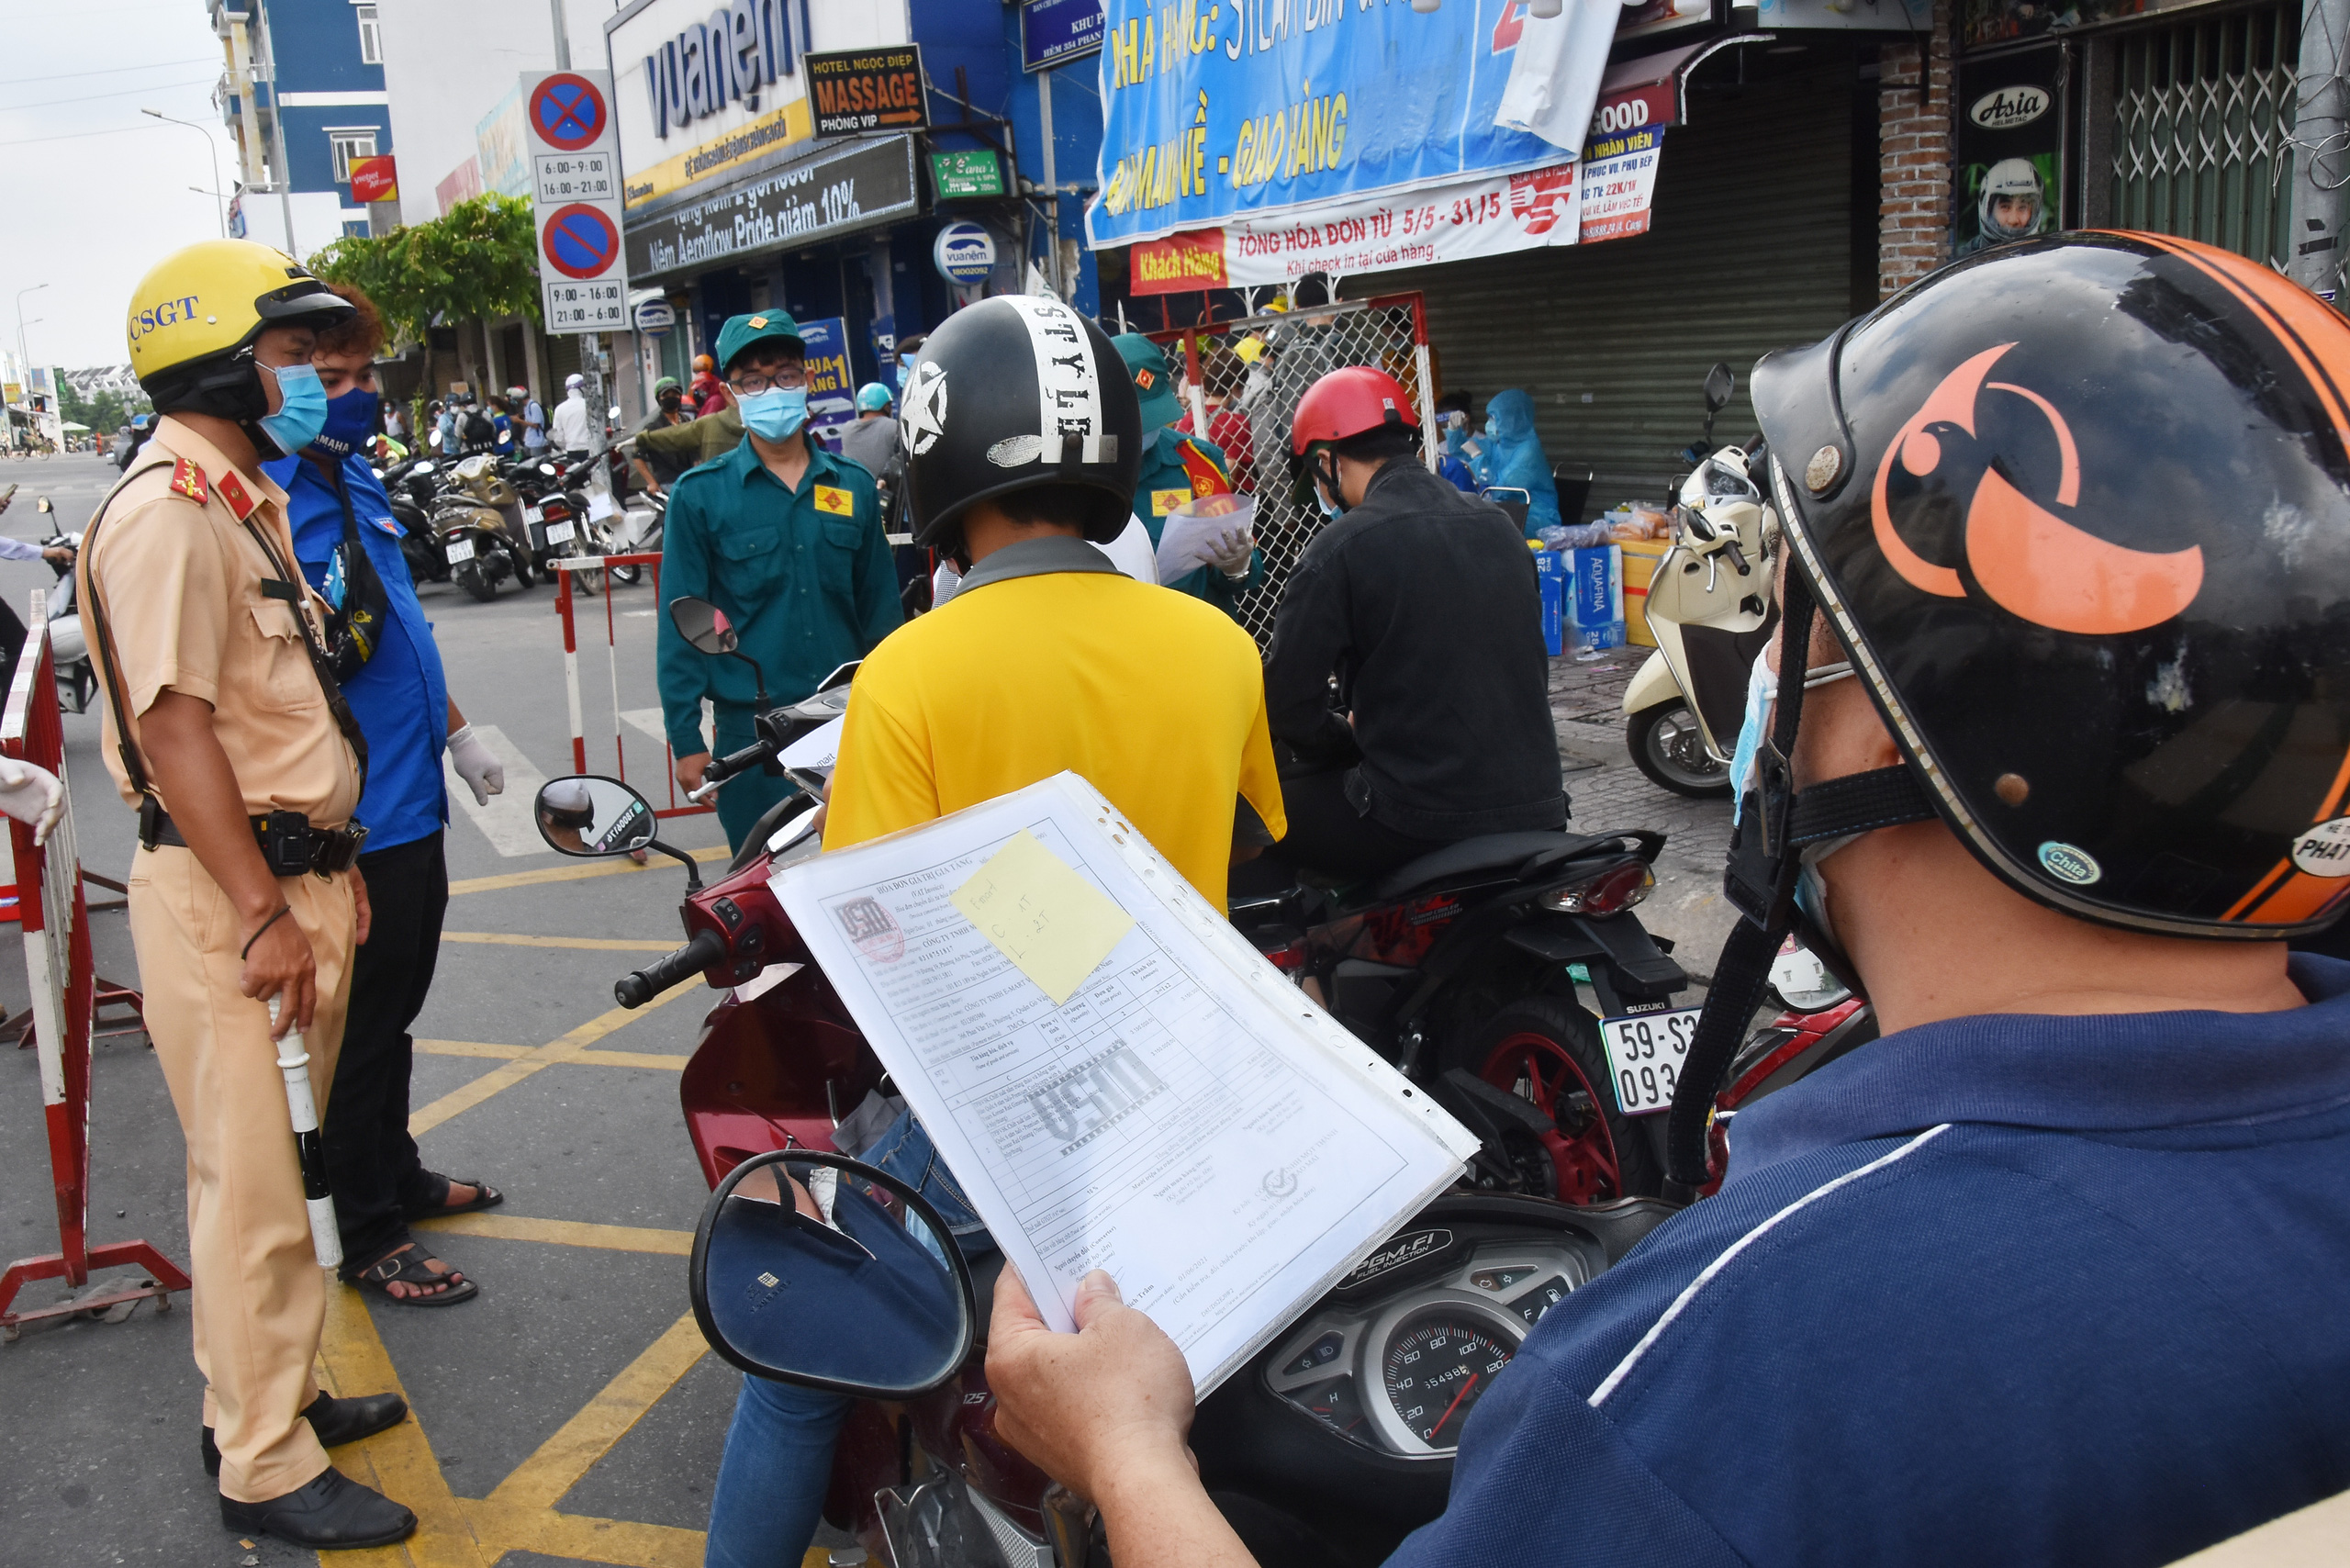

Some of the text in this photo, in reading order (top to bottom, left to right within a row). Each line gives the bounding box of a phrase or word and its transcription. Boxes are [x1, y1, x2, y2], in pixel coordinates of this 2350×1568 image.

[1071, 15, 1094, 34] KHU
[1078, 30, 1102, 47] PHAN
[813, 52, 912, 73] HOTEL NGỌC ĐIỆP
[816, 73, 918, 115] MASSAGE
[1978, 92, 2041, 123] Asia
[821, 114, 878, 132] PHÒNG VIP
[1181, 87, 1208, 197] VỀ
[1233, 110, 1285, 190] GIAO
[1284, 77, 1348, 180] HÀNG
[1595, 138, 1625, 159] NHÂN
[1627, 131, 1652, 152] VIÊN
[678, 223, 734, 264] Aeroflow
[734, 207, 775, 249] Pride
[822, 178, 861, 225] 10%
[1239, 223, 1281, 258] TỔNG
[1285, 221, 1323, 252] HÓA
[1326, 216, 1366, 246] ĐƠN
[1370, 207, 1393, 240] TỪ
[1403, 206, 1436, 236] 5/5
[1450, 192, 1502, 226] 31/5
[946, 250, 987, 263] vuanệm
[1140, 246, 1221, 282] Khách Hàng
[1287, 259, 1305, 275] Khi
[1308, 255, 1340, 274] check
[1344, 253, 1356, 269] in
[1359, 250, 1373, 270] tại
[1401, 243, 1434, 262] hàng
[129, 296, 199, 341] CSGT
[832, 354, 849, 388] 1
[808, 375, 837, 397] ẠNG
[315, 433, 349, 453] AMAHA
[1537, 556, 1546, 573] 28
[1591, 557, 1605, 613] AQUAFINA
[1591, 632, 1599, 645] 28
[2050, 851, 2087, 878] Chita
[876, 868, 949, 893] HÓA ĐƠN GIÁ TRỊ GIA
[922, 935, 940, 947] CÔNG
[949, 925, 968, 937] TNHH
[963, 1000, 979, 1011] CÔNG
[987, 991, 1003, 1001] TNHH
[1002, 980, 1025, 993] E-MART
[1626, 1002, 1665, 1014] SUZUKI
[1007, 1018, 1026, 1030] TM/CK
[1041, 1020, 1053, 1028] Đơn
[1620, 1062, 1677, 1107] 093
[1350, 1232, 1435, 1277] PGM-FI
[1356, 1245, 1429, 1280] FUEL INJECTION
[1523, 1308, 1533, 1320] F
[1429, 1336, 1447, 1350] 80
[1459, 1341, 1477, 1356] 100
[1404, 1350, 1421, 1365] 60
[1485, 1359, 1505, 1374] 120
[1395, 1377, 1414, 1391] 40
[963, 1392, 988, 1405] 125
[1329, 1392, 1338, 1404] H
[1406, 1406, 1424, 1420] 20
